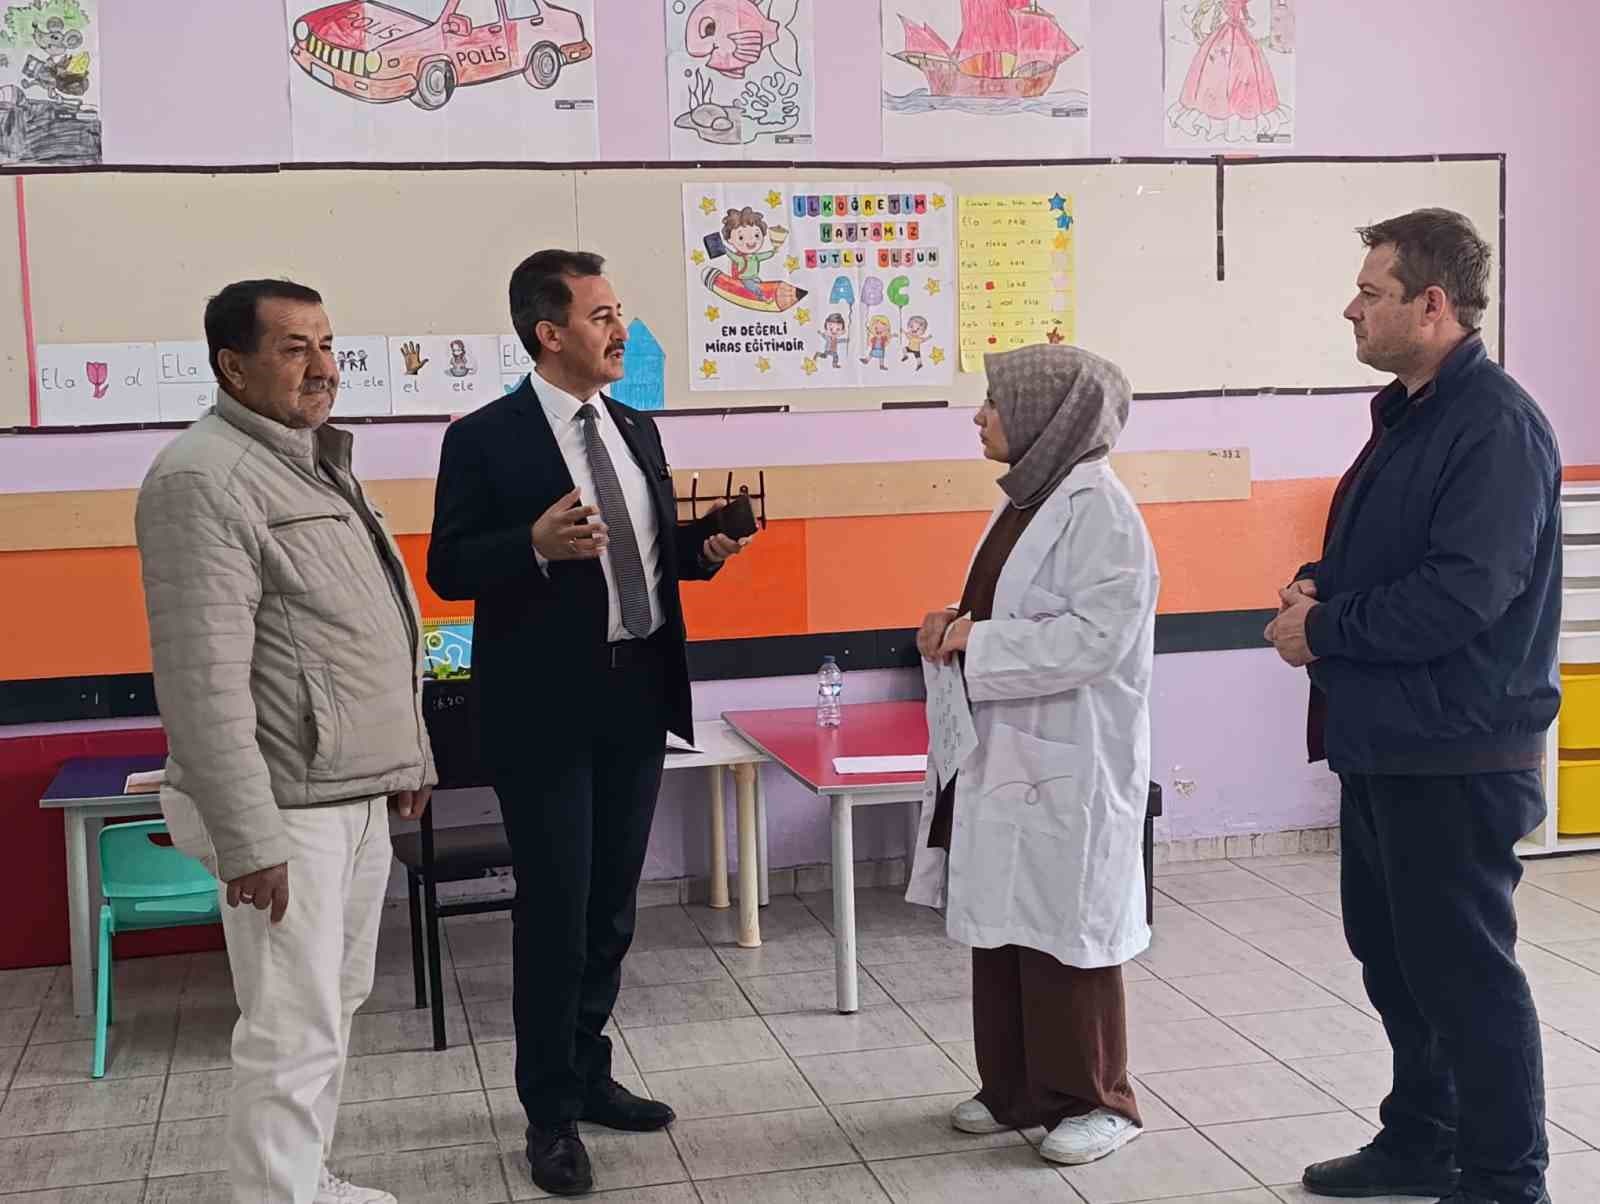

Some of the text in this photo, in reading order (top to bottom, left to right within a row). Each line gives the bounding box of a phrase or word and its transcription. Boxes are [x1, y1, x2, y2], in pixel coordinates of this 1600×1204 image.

[456, 45, 507, 67] POLİS
[793, 194, 927, 216] İLKOĞRETİM
[820, 222, 919, 242] HAFTAMIZ
[805, 249, 865, 267] KUTLU
[878, 248, 938, 267] OLSUN
[721, 321, 788, 337] EN DEĞERLİ
[705, 337, 805, 353] MİRAS EĞİTİMDİR
[162, 353, 197, 378] Ela
[42, 367, 143, 390] Ela al
[402, 379, 420, 393] el
